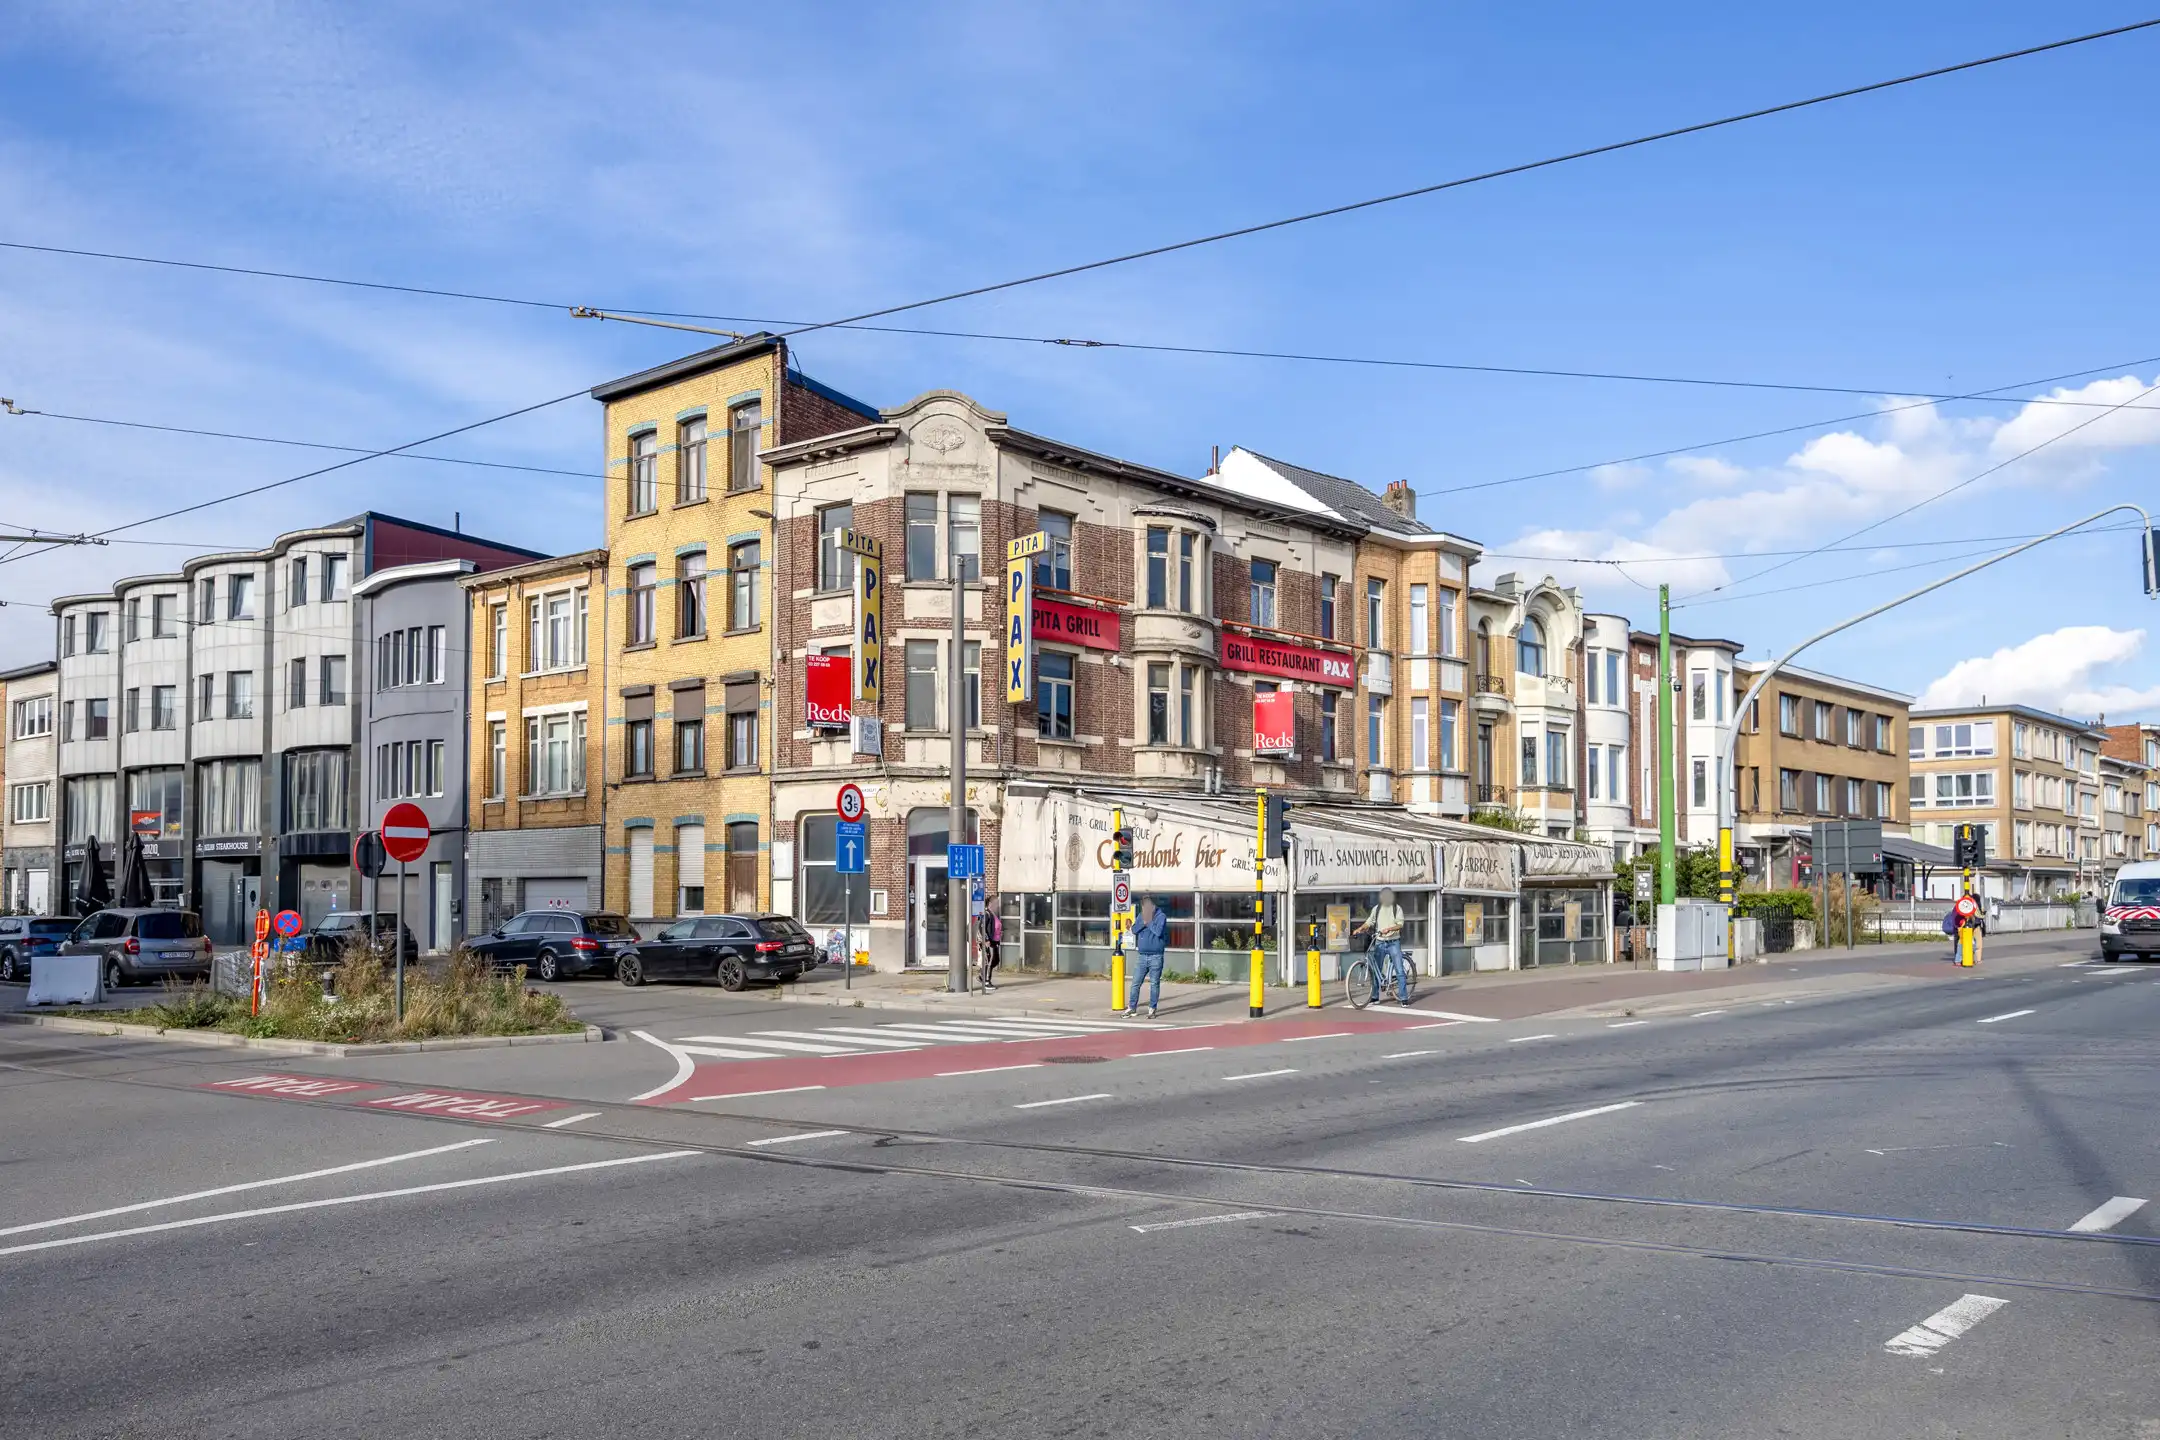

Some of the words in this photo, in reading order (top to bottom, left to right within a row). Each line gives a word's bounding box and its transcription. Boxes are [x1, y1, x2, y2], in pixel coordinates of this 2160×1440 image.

[848, 531, 874, 553] PITA
[1014, 535, 1039, 556] PITA
[864, 567, 877, 689] PAX
[1010, 570, 1023, 691] PAX
[1032, 609, 1061, 632] PITA
[1066, 615, 1101, 638] GRILL
[1227, 643, 1256, 663] GRILL
[1259, 648, 1321, 673] RESTAURANT
[1323, 659, 1351, 679] PAX
[806, 702, 851, 722] Reds
[1255, 731, 1294, 749] Reds
[1068, 813, 1082, 827] PITA
[1089, 818, 1108, 832] GRILL
[215, 841, 249, 851] STEAKHOUSE
[1194, 834, 1228, 869] bier
[1304, 848, 1326, 867] PITA
[1336, 848, 1389, 867] SANDWICH
[1397, 849, 1427, 867] SNACK
[1117, 888, 1127, 898] 30
